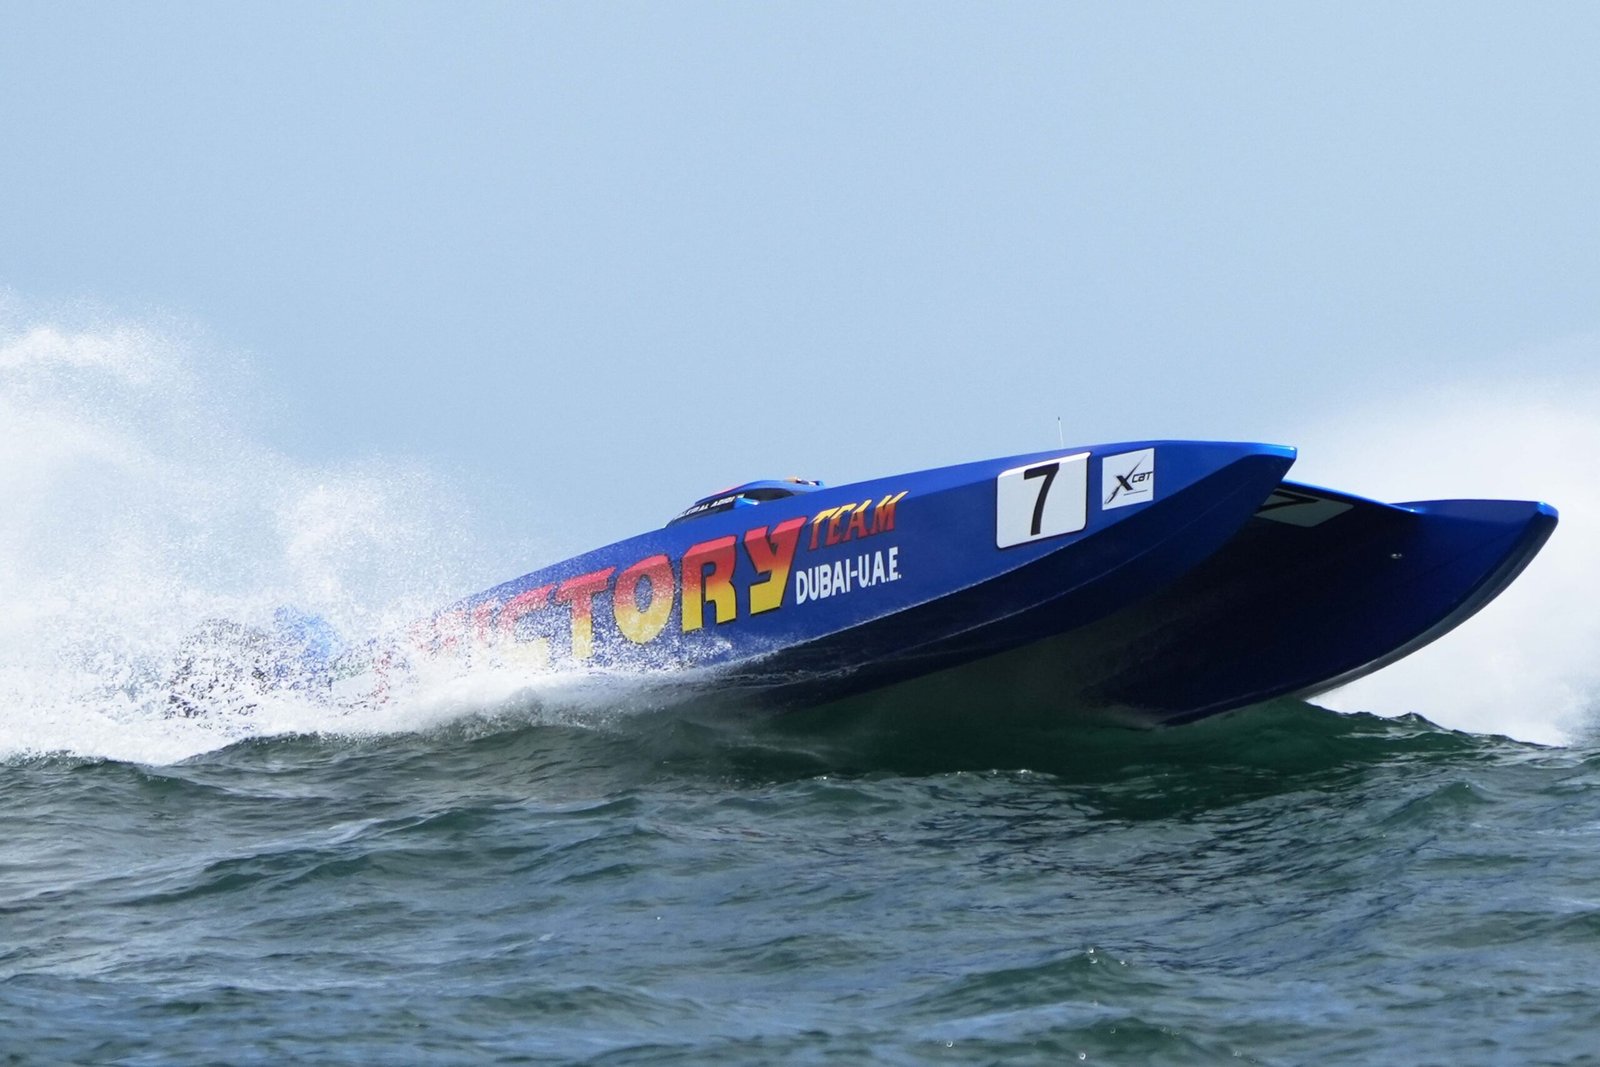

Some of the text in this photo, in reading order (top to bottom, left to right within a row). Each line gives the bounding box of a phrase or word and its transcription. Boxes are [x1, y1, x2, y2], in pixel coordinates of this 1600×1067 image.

[807, 490, 910, 550] TEAM
[1024, 463, 1060, 536] 7
[795, 546, 902, 604] DUBAI-U.A.E.
